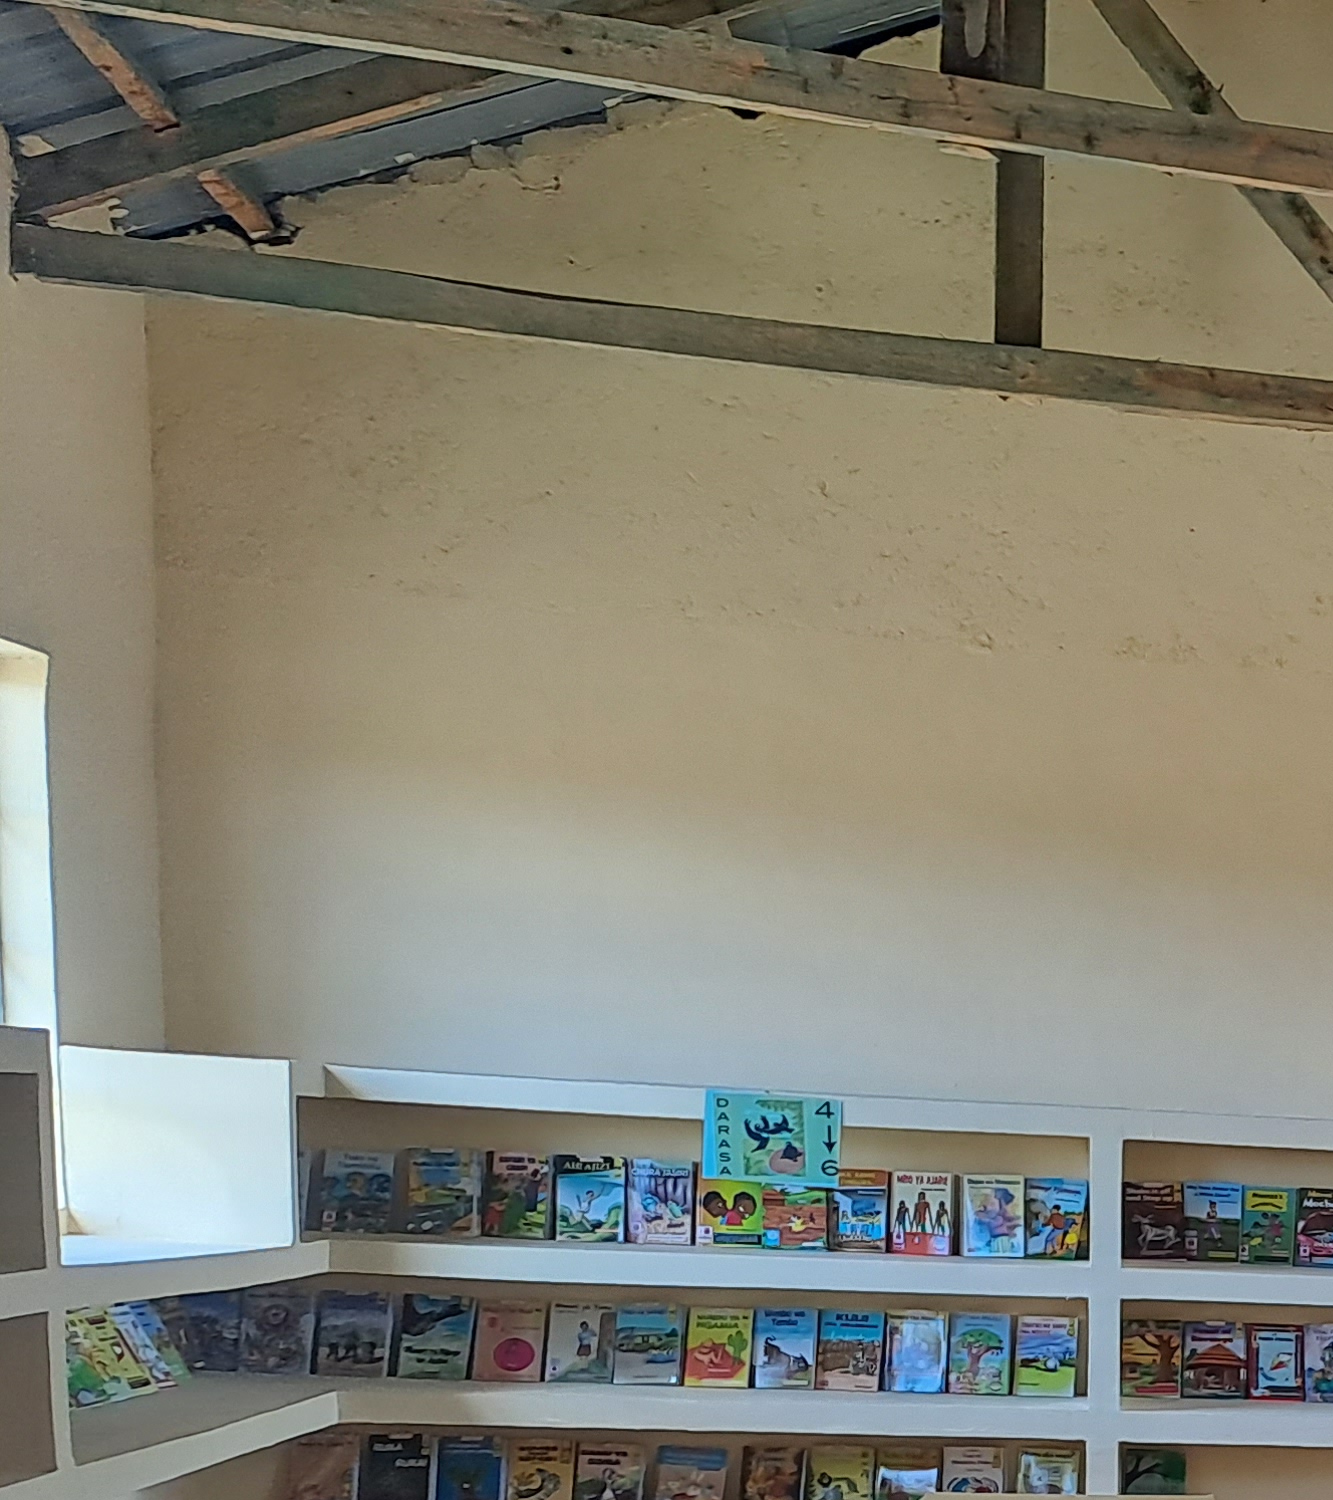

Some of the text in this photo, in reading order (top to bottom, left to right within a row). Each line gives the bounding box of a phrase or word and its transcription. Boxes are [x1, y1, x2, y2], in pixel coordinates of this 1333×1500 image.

[815, 1101, 834, 1119] 4
[716, 1098, 732, 1175] DARASA
[821, 1160, 839, 1176] 6
